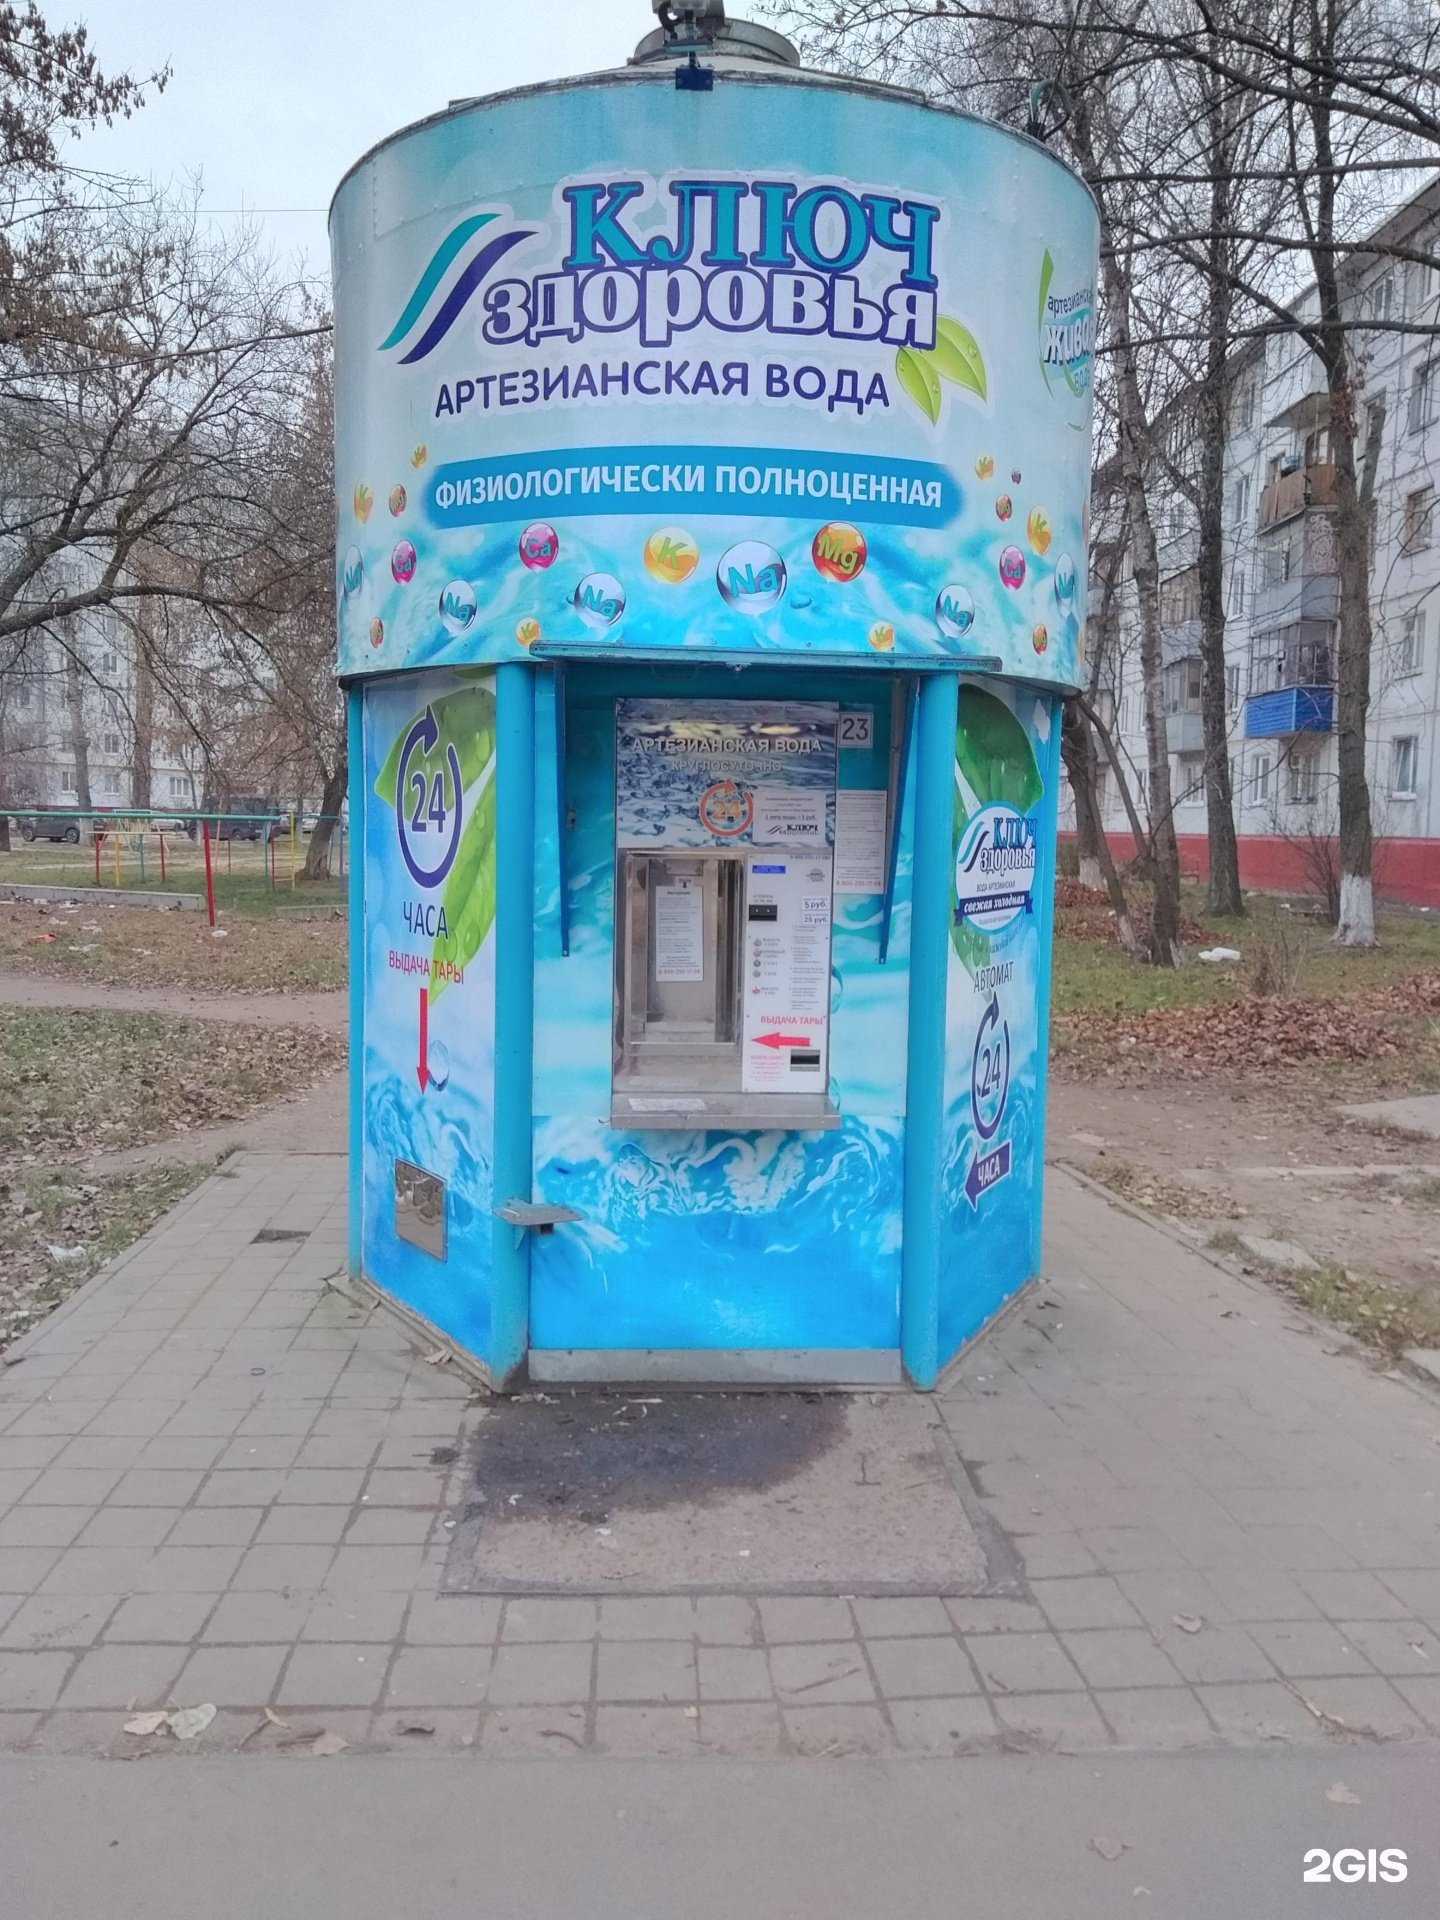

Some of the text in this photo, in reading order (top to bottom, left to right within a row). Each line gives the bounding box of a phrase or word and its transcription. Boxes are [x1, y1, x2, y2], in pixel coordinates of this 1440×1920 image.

[563, 180, 940, 286] КЛЮЧ
[482, 264, 937, 350] здоровья
[434, 360, 890, 418] АРТЕЗИАНСКАЯ ВОДА
[435, 463, 942, 510] ФИЗИОЛОГИЧЕСКИ ПОЛНОЦЕННАЯ
[525, 538, 551, 558] Ca
[656, 537, 687, 570] K
[816, 536, 858, 574] Mg
[728, 563, 779, 598] Na
[446, 592, 472, 622] Na
[583, 585, 620, 619] Na
[943, 595, 969, 627] Na
[632, 738, 823, 753] АРТЕЗИАНСКАЯ ВОДА
[842, 719, 869, 740] 23
[671, 760, 782, 772] КРУГЛОСУТОЧНО
[410, 771, 446, 833] 24
[993, 817, 1037, 850] КЛЮЧ
[402, 901, 449, 939] ЧАСА
[388, 949, 464, 985] ВЫДАЧА ТАРЫ
[973, 961, 1014, 993] АВТОМАТ
[979, 1043, 1001, 1099] 24
[976, 1160, 1001, 1188] ЧАСА
